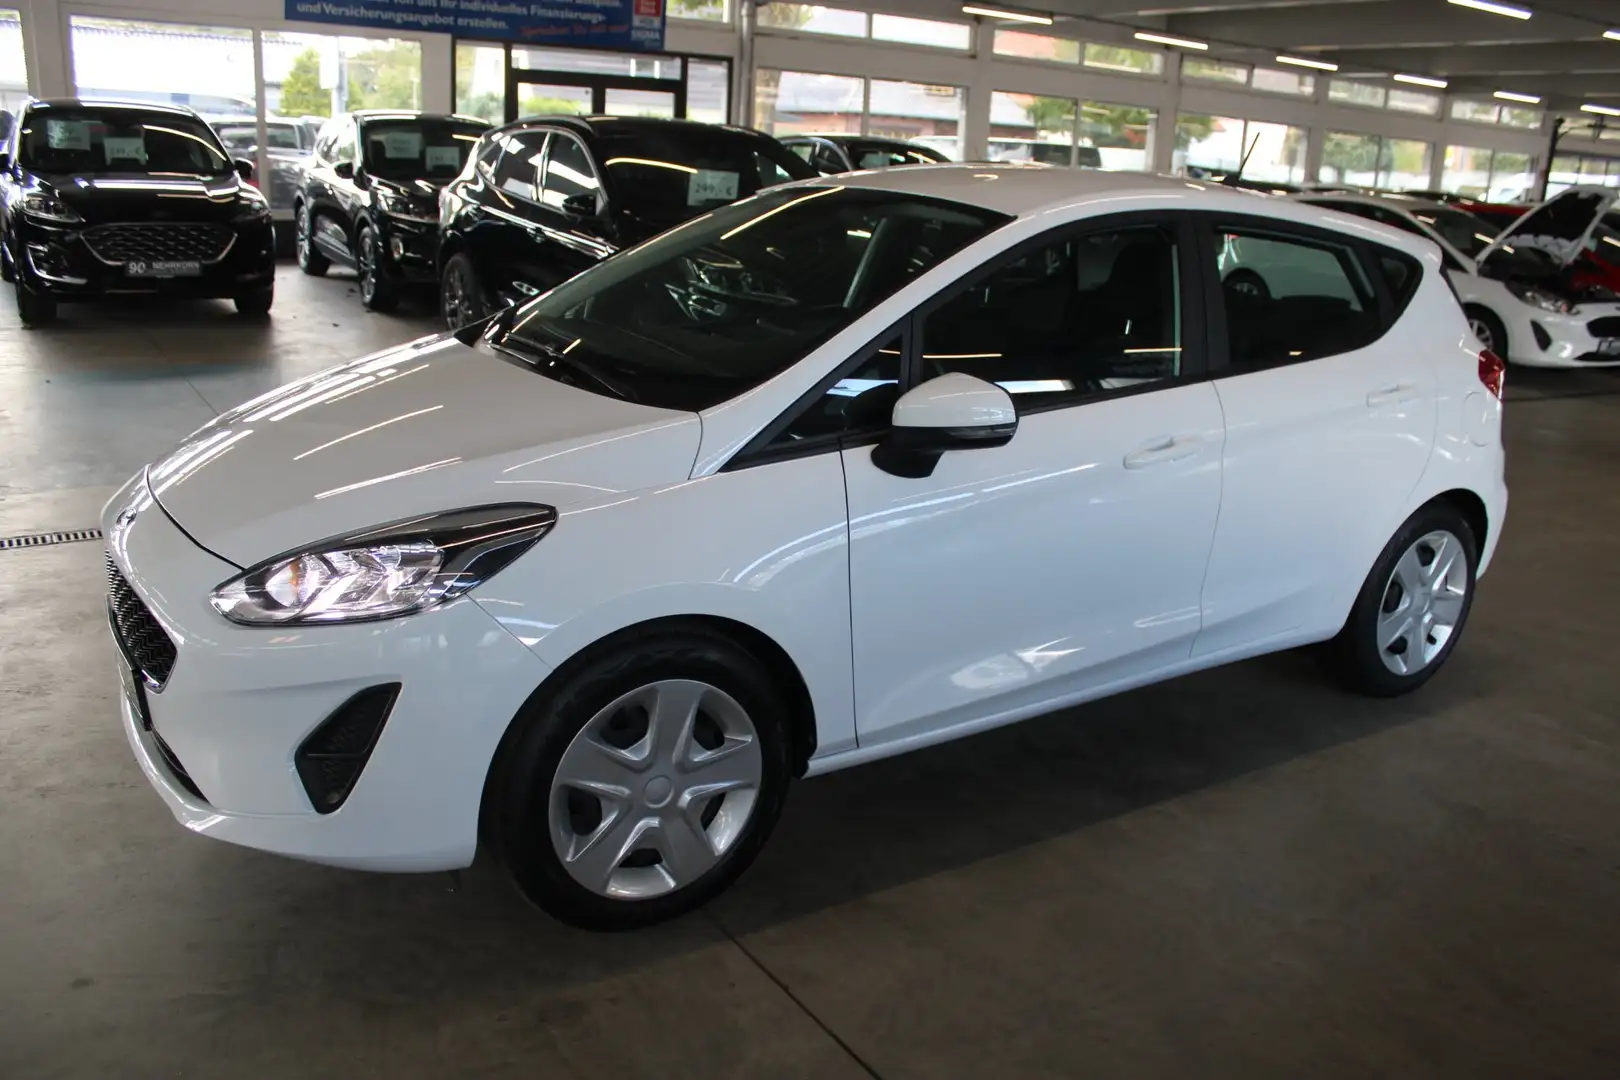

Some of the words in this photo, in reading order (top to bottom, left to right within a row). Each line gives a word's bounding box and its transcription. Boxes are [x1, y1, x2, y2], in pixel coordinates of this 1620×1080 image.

[296, 2, 321, 14] und
[321, 2, 456, 27] Versicherungsangebot
[457, 17, 510, 30] erstellen.
[459, 1, 529, 16] individuelles
[530, 5, 607, 24] Finanzierungs-
[128, 262, 146, 274] 90
